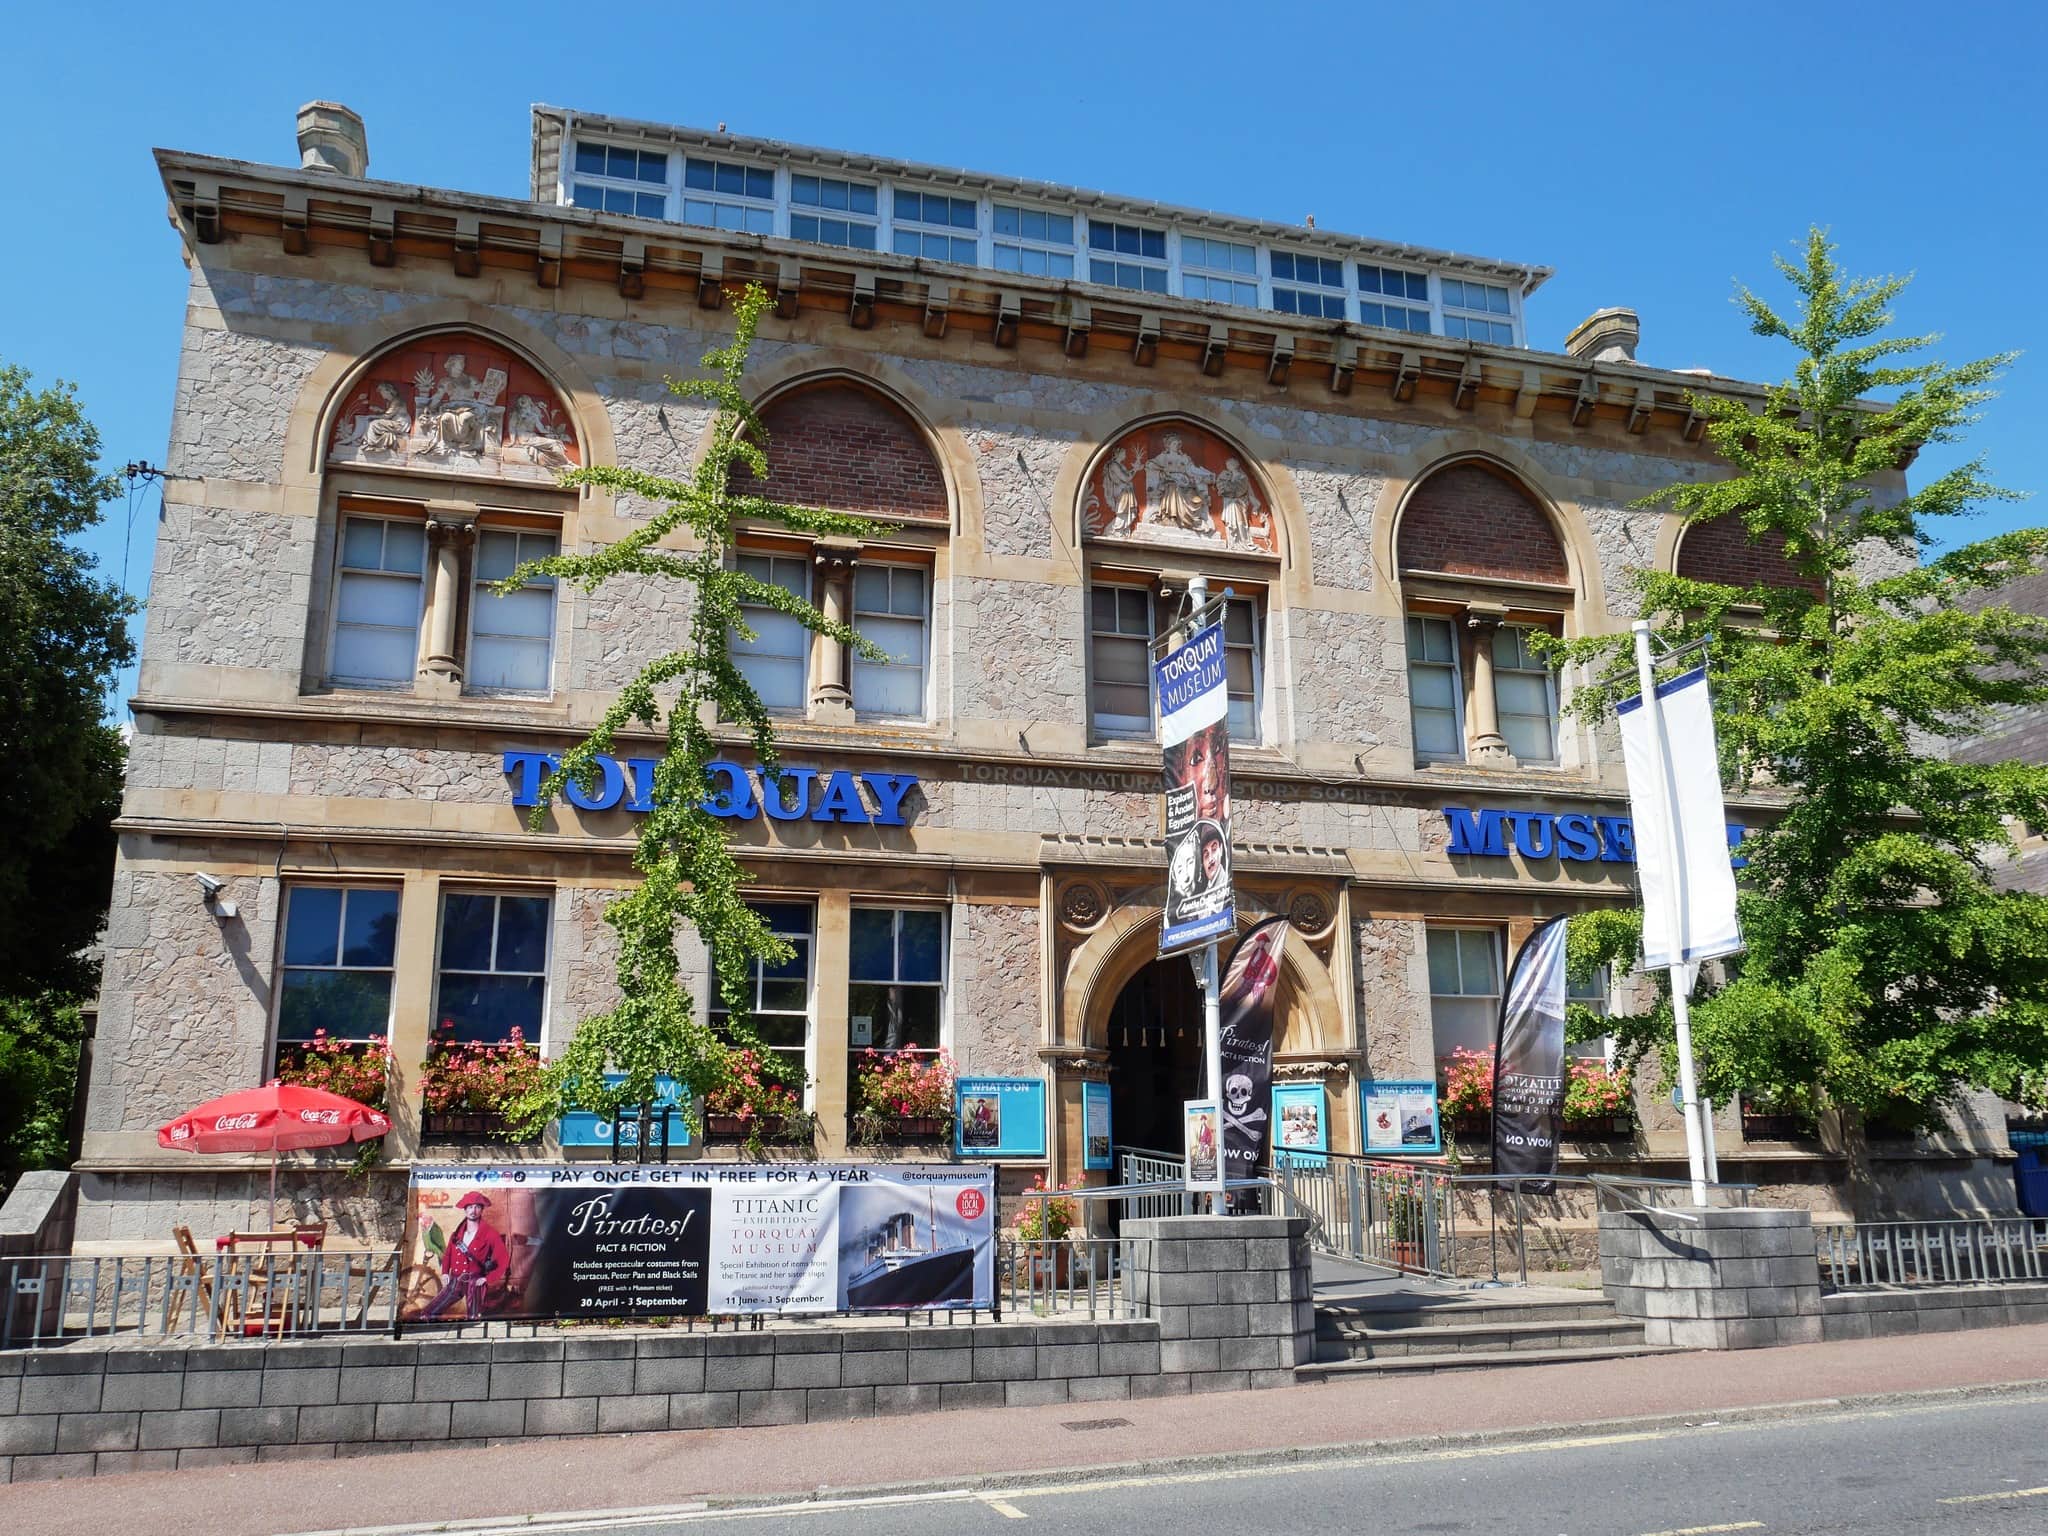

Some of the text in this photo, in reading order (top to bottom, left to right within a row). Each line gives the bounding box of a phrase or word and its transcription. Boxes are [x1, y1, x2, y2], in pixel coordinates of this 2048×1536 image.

[1161, 631, 1218, 685] TORQUAY
[1167, 659, 1222, 710] MUSEUM
[957, 764, 1409, 804] TORQUAY NATURA STORY SOCIETY
[1442, 807, 1749, 869] MUSE
[1220, 1051, 1232, 1060] ACT
[971, 1082, 1030, 1092] WHAT'S ON
[1373, 1085, 1424, 1095] WHAT'S ON
[412, 1171, 444, 1181] Follow
[551, 1169, 869, 1183] PAY ONCE GET IN FREE FOR A YEAR
[902, 1171, 988, 1183] @torquaymuseum
[732, 1199, 818, 1214] TITANIC
[962, 1199, 978, 1209] LOCAL
[567, 1193, 696, 1242] Pirates!
[743, 1216, 808, 1225] EXHIBITION
[732, 1228, 818, 1240] TORQUAY
[595, 1243, 667, 1253] FACT & FICTION
[731, 1243, 818, 1255] MUSEUM
[573, 1259, 699, 1270] Includes spectacular costumes from
[720, 1261, 744, 1271] Special
[745, 1260, 780, 1270] Exhibition
[781, 1260, 790, 1268] of
[573, 1270, 698, 1282] Spartacus, Peter Pan and Black Sails
[722, 1270, 734, 1280] the
[735, 1270, 758, 1280] Titanic
[760, 1270, 772, 1279] and
[774, 1270, 786, 1279] her
[598, 1284, 614, 1292] (FREE
[580, 1298, 592, 1308] 30
[594, 1298, 619, 1309] April
[627, 1297, 634, 1306] 3
[636, 1297, 688, 1307] September
[726, 1297, 736, 1306] 11
[738, 1296, 759, 1307] June
[768, 1297, 773, 1305] 3
[775, 1295, 825, 1306] September
